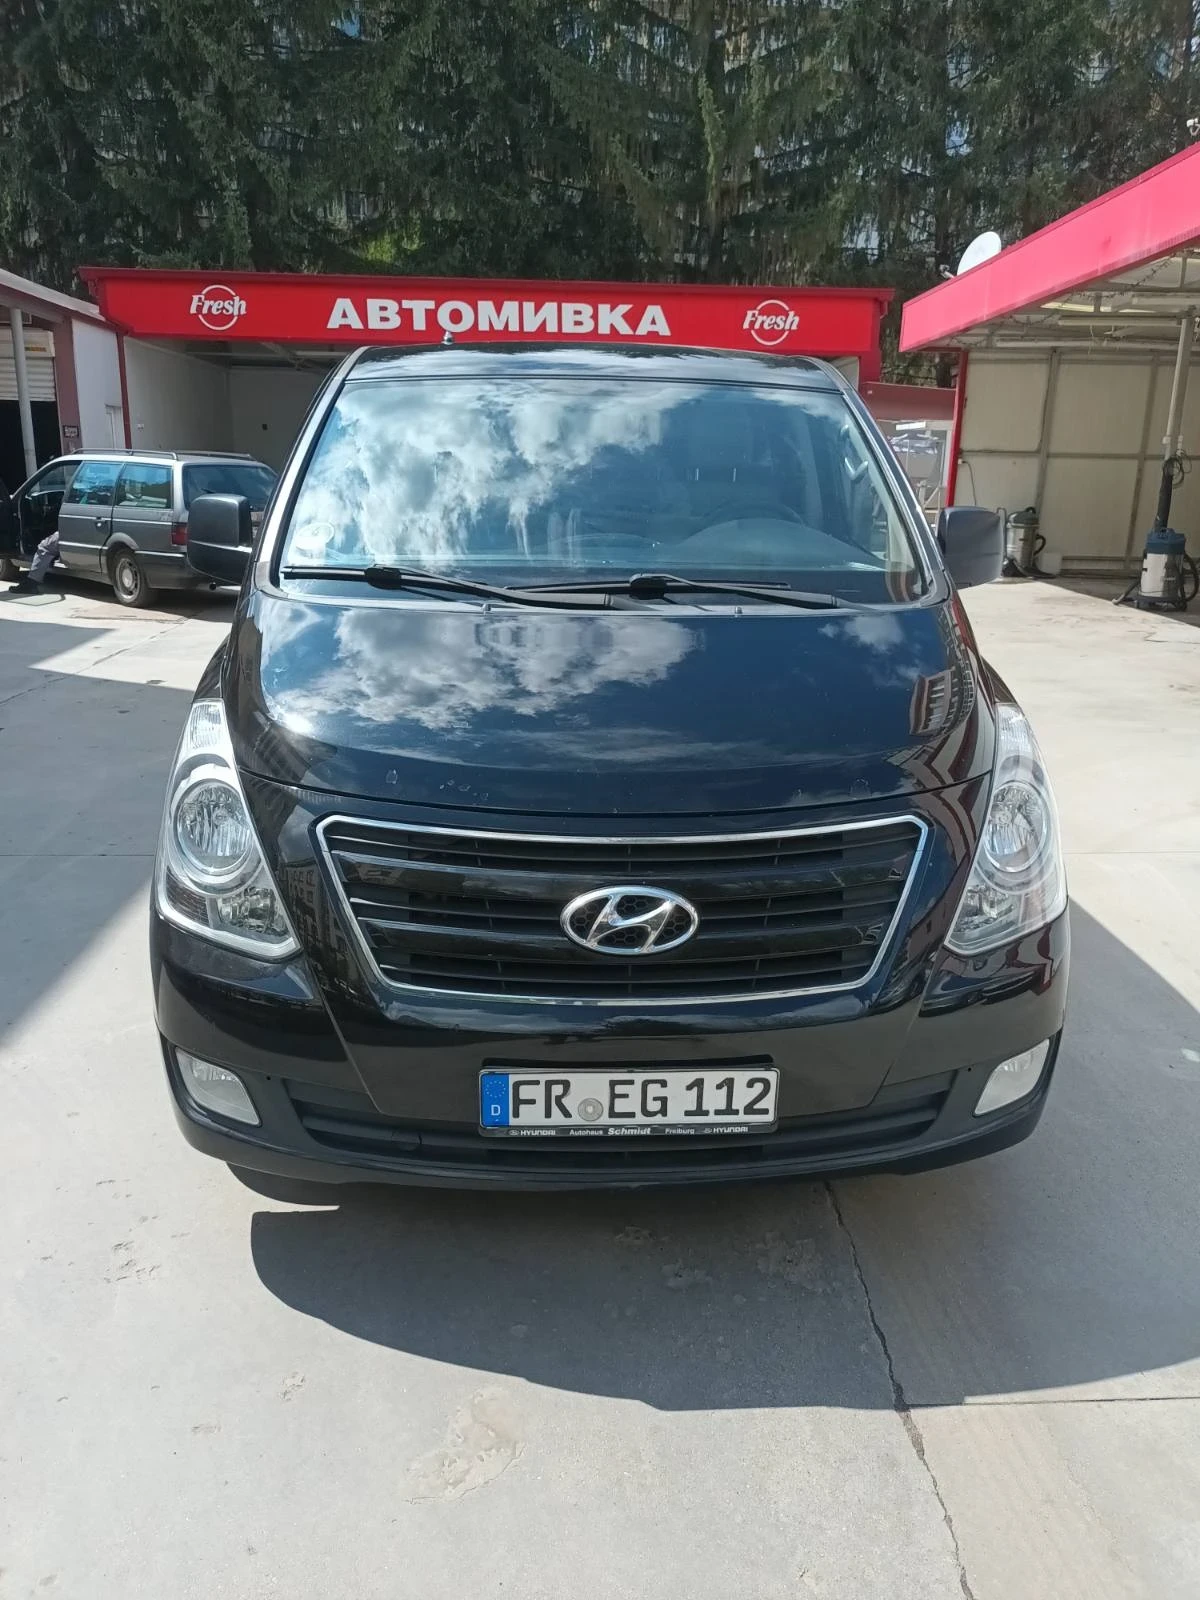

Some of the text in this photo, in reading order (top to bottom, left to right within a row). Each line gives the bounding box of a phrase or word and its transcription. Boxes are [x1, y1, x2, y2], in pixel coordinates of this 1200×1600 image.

[190, 294, 247, 315] Fresh
[326, 298, 671, 336] АВТОМИВКА
[742, 310, 800, 331] Fresh
[511, 1077, 772, 1119] FR EG 112
[491, 1104, 501, 1116] D
[607, 1127, 652, 1136] Schmidt
[664, 1127, 695, 1136] Freiburg
[713, 1126, 749, 1134] HYUNDAI
